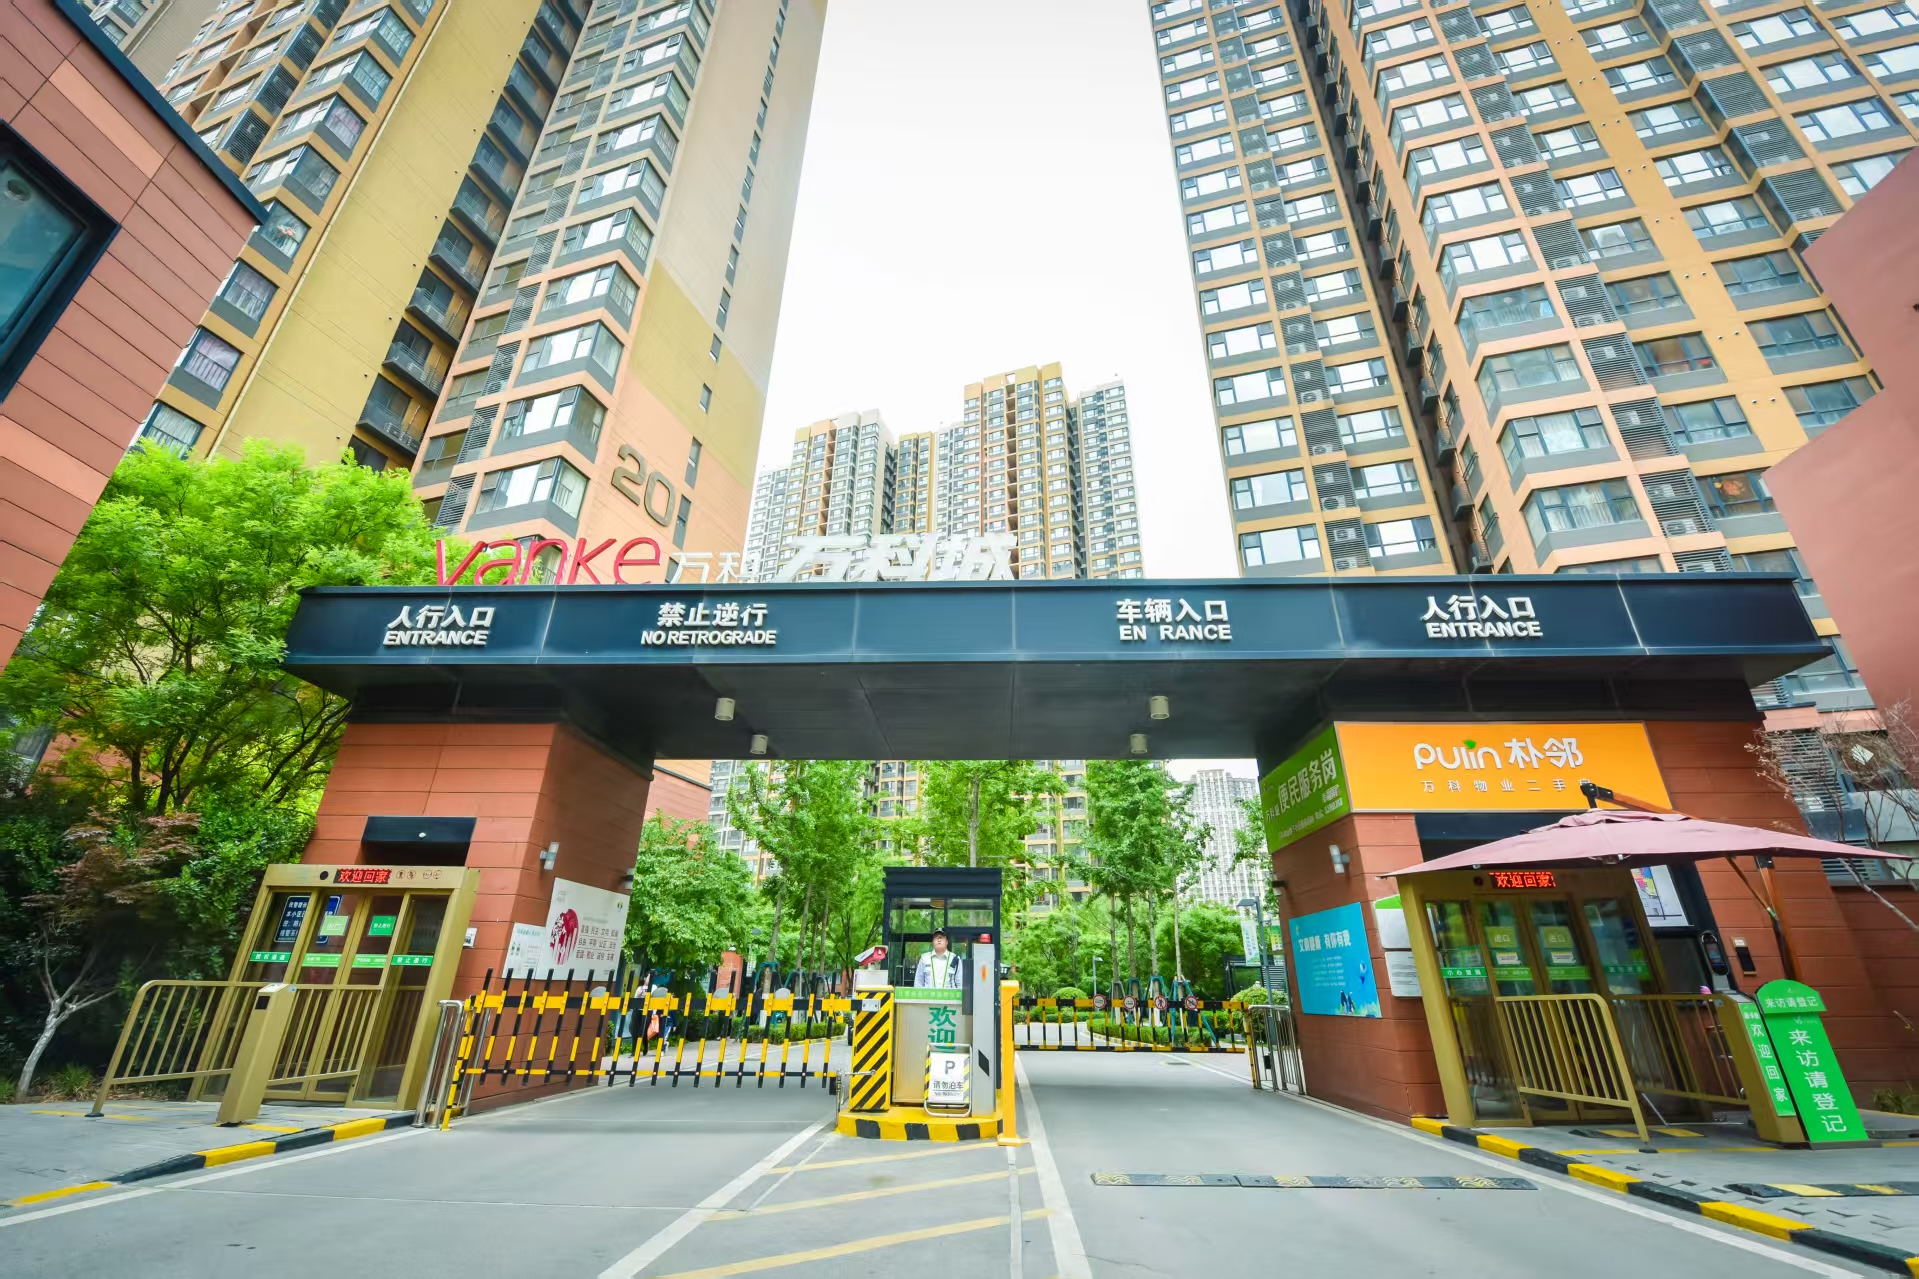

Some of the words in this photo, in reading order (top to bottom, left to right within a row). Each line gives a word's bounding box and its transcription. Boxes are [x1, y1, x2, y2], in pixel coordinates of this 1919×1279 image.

[610, 443, 676, 527] 20
[436, 537, 661, 585] vanke
[386, 604, 496, 630] 人行入口
[656, 602, 768, 628] 禁止逆行
[1116, 597, 1229, 624] 车辆入口
[1420, 594, 1537, 622] 人行入口
[382, 630, 490, 647] ENTRANCE
[641, 629, 667, 646] NO
[667, 629, 777, 646] RETROGRADE
[1425, 621, 1544, 639] ENTRANCE
[1504, 737, 1584, 769] 朴邻
[1278, 748, 1337, 813] 便民服务岗
[339, 869, 389, 883] 欢迎回家
[1495, 874, 1551, 887] 欢迎回家
[1765, 996, 1819, 1008] 来访请登记
[945, 1060, 956, 1075] P
[1750, 1023, 1788, 1103] 欢迎回家
[933, 1080, 964, 1090] 请勿泊车
[1788, 1029, 1848, 1133] 来访请登记
